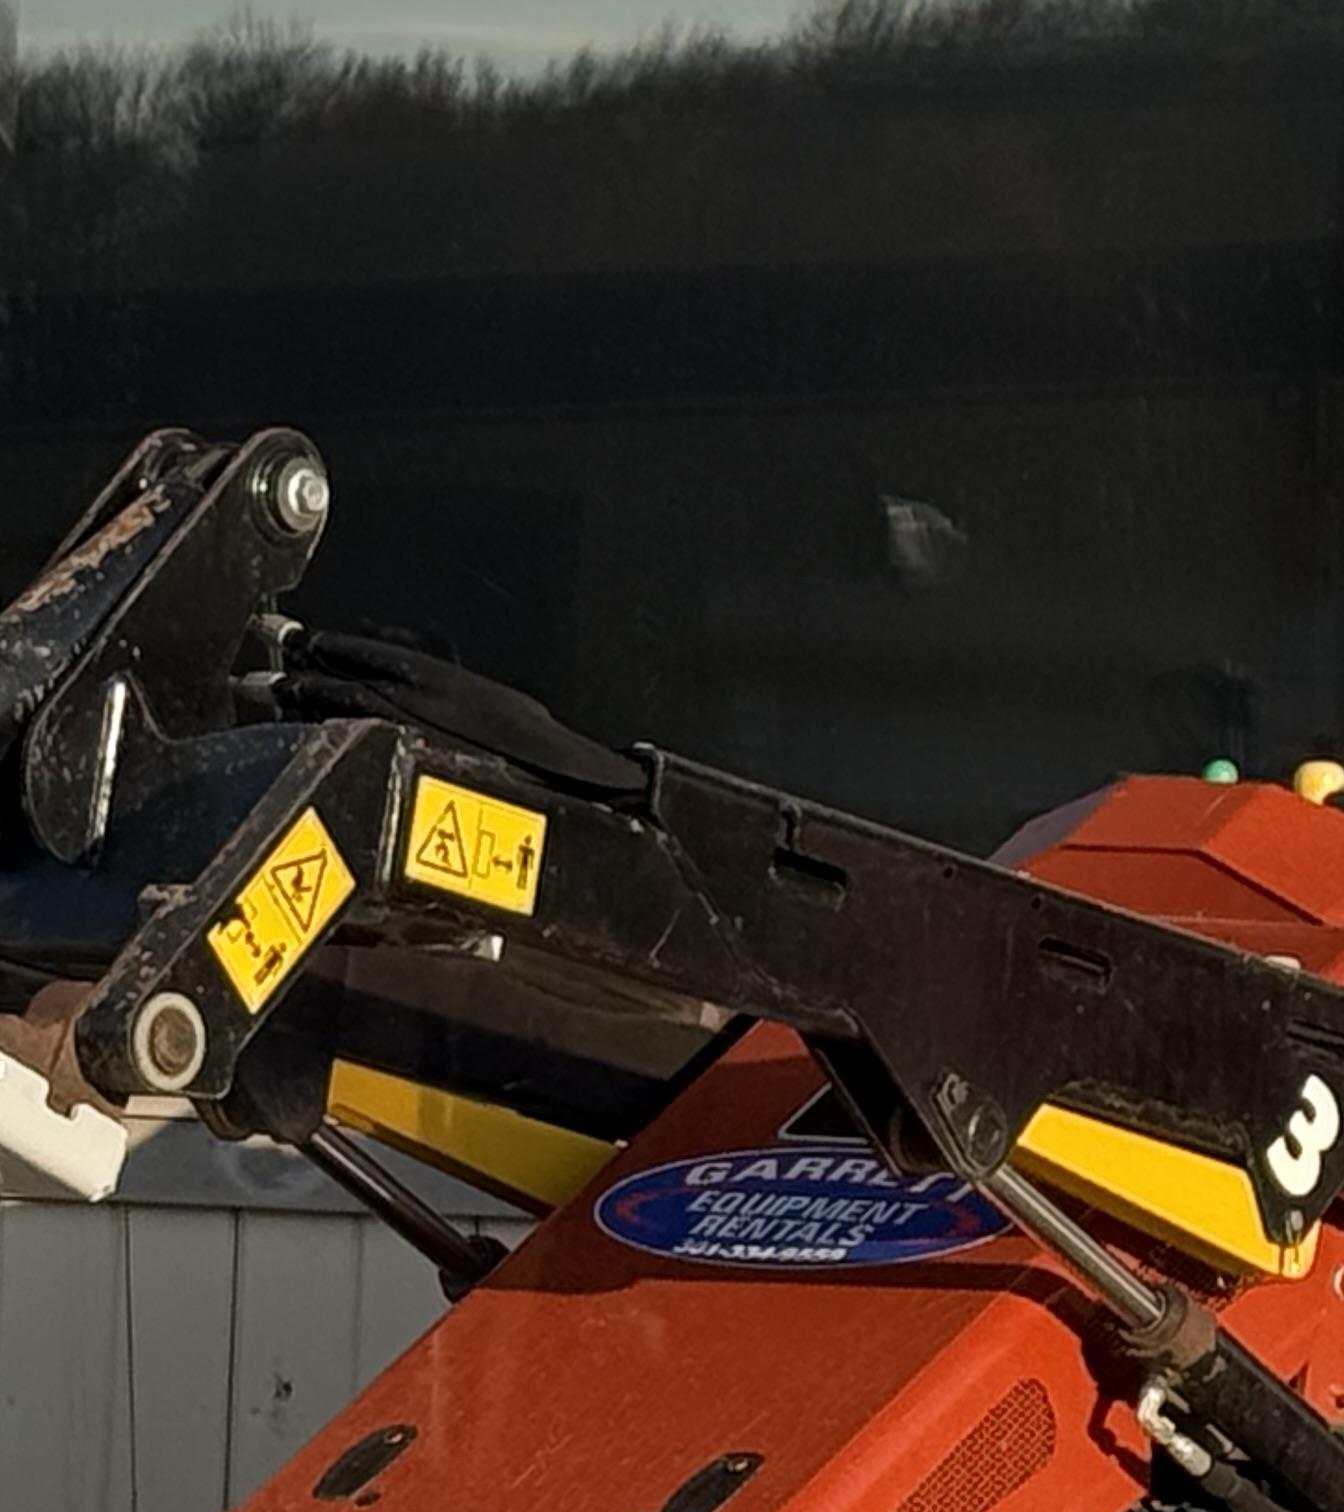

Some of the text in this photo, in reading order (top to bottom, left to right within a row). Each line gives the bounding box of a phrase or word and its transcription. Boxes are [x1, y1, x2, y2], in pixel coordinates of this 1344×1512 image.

[1266, 1073, 1341, 1197] 3
[684, 1189, 932, 1228] EQUIPMENT
[687, 1213, 878, 1249] RENTALS
